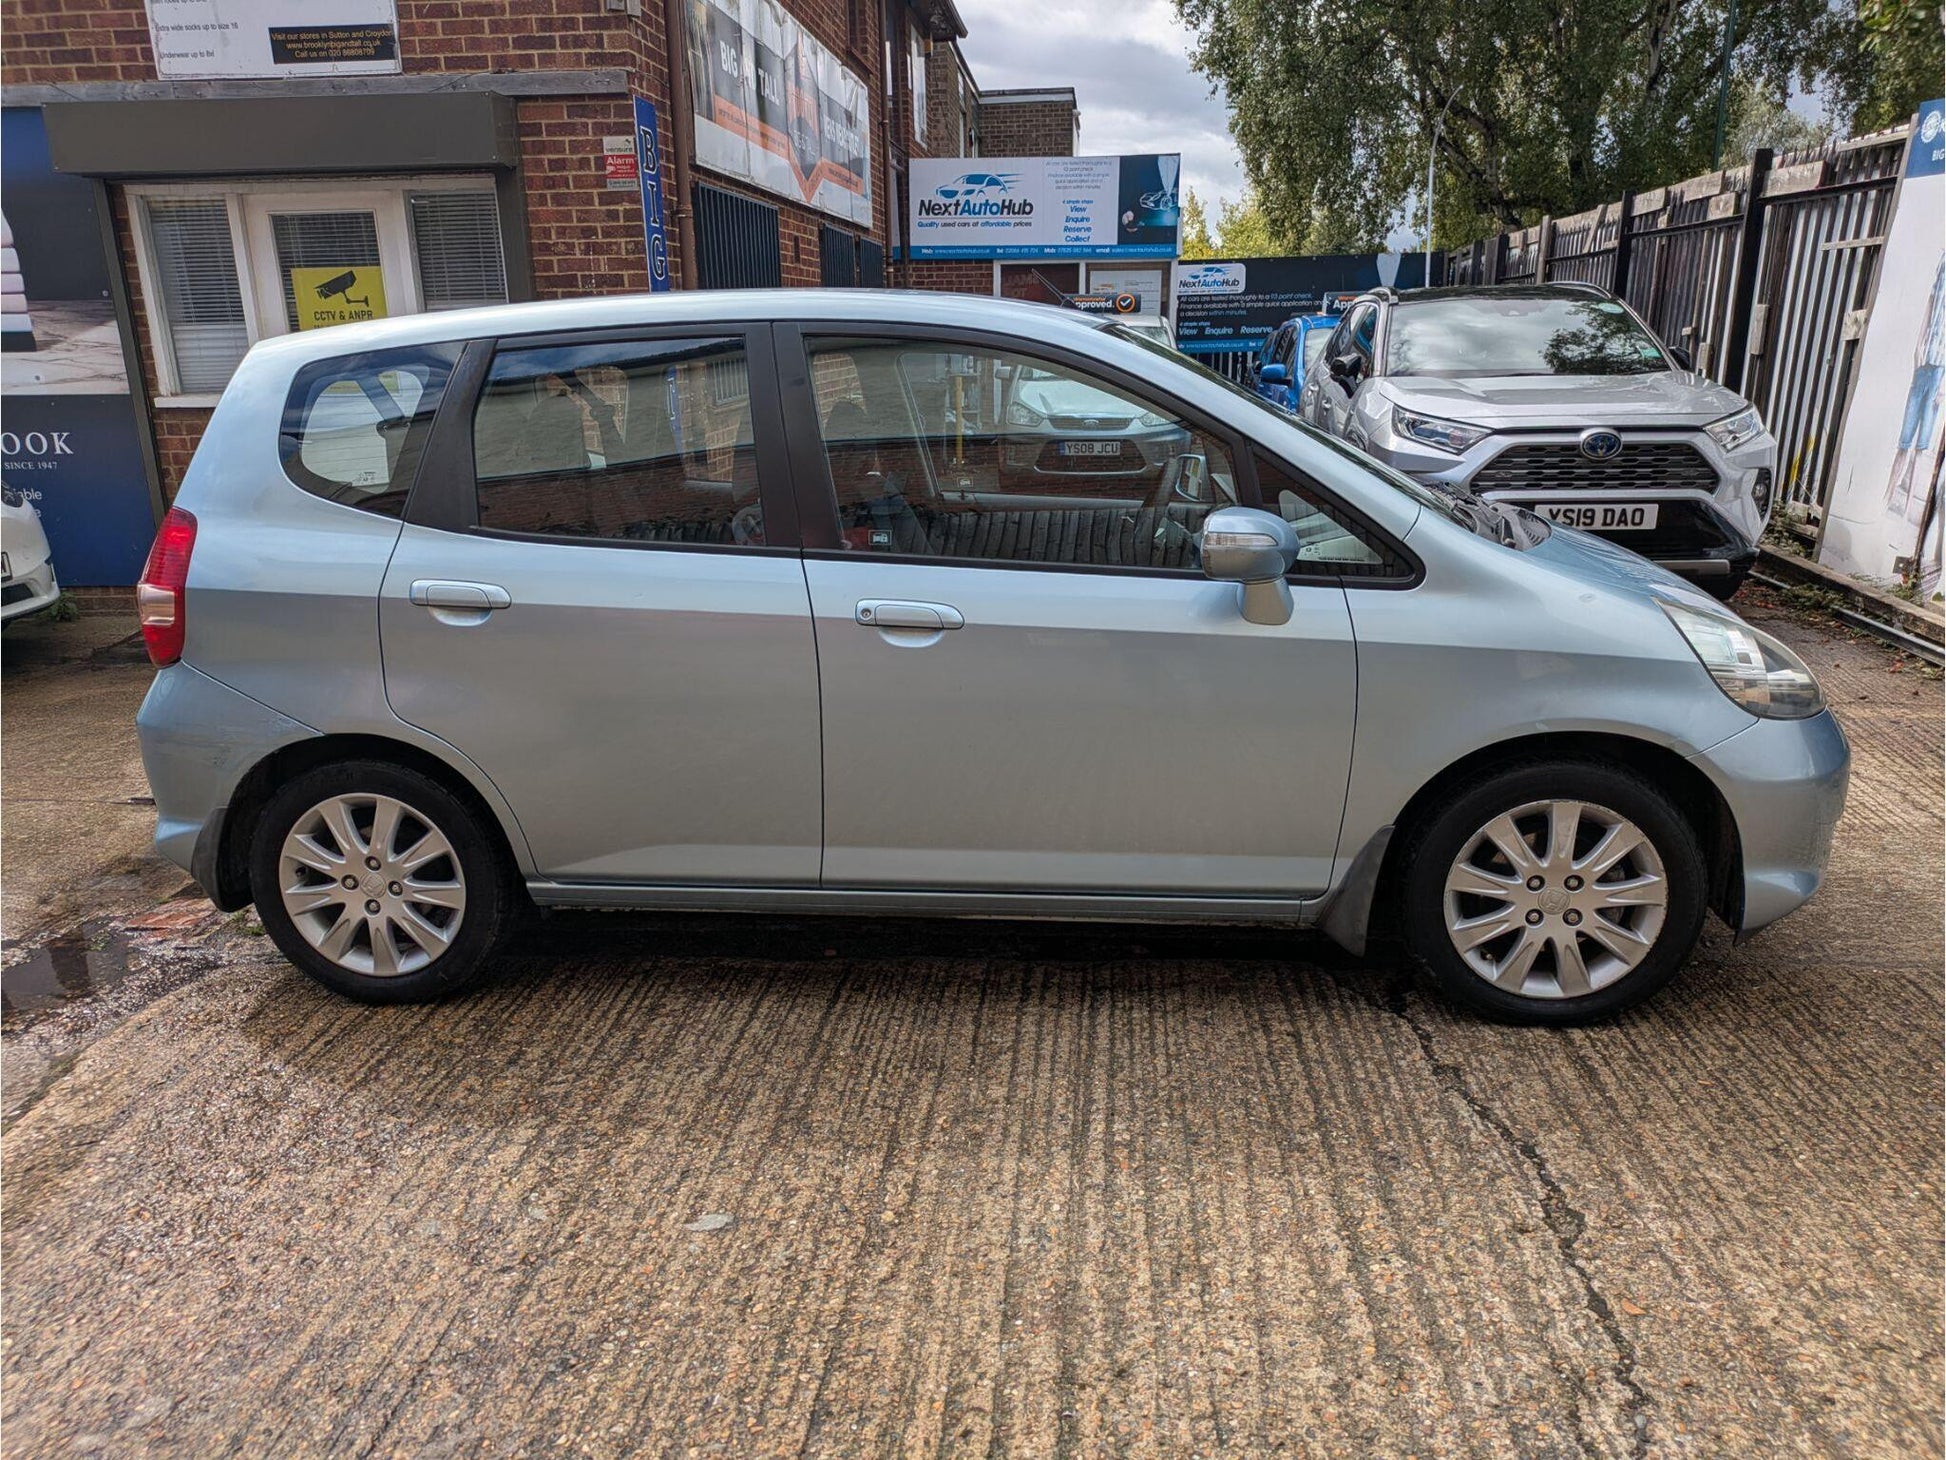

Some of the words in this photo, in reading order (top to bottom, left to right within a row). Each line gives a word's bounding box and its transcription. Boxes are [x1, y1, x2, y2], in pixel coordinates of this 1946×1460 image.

[271, 32, 286, 40] Visit
[300, 32, 320, 40] stores
[294, 50, 308, 58] Call
[719, 39, 738, 78] BIG
[758, 67, 780, 106] TALL
[606, 156, 635, 164] Alarm
[640, 125, 666, 280] BIG
[918, 199, 1034, 216] NextAutoHub
[917, 221, 939, 229] Quality
[1012, 221, 1032, 229] prices
[1065, 216, 1090, 224] Enquire
[1178, 278, 1240, 289] NextAutoHub
[314, 310, 336, 321] CCTV
[339, 310, 346, 320] &
[348, 310, 373, 320] ANPR
[1179, 328, 1198, 336] View
[1204, 326, 1234, 336] Enquire
[1240, 326, 1273, 334] Reserve
[1066, 443, 1095, 454] YS08
[1096, 443, 1118, 454] JCU
[4, 462, 34, 470] SINCE
[38, 461, 58, 470] 1947
[1548, 508, 1596, 527] YS19
[1601, 508, 1645, 527] DAO
